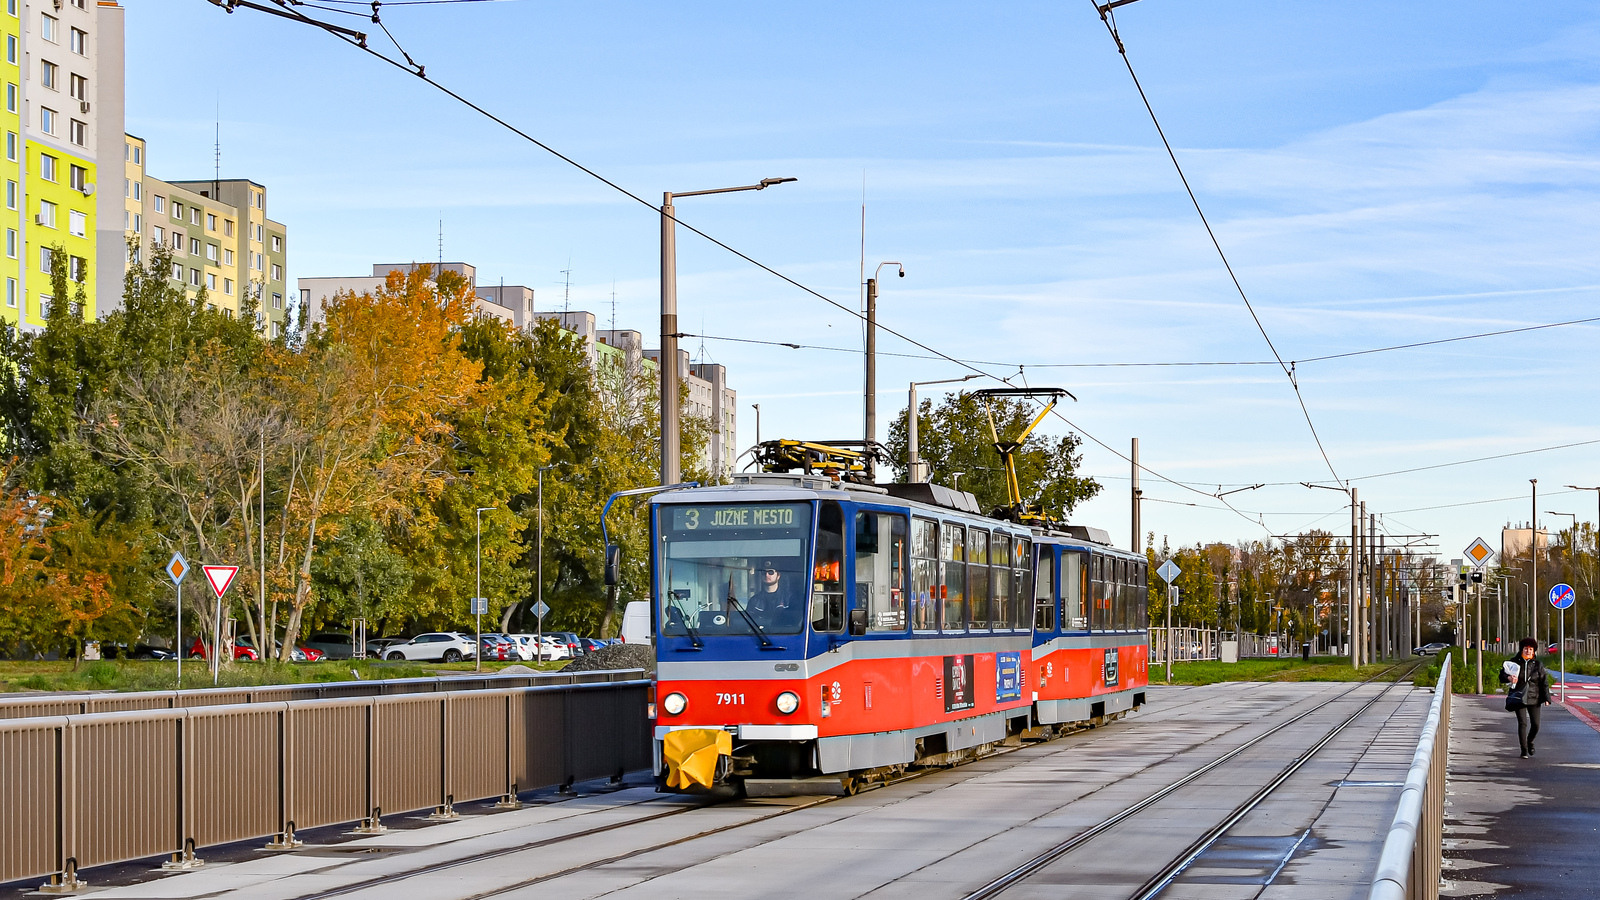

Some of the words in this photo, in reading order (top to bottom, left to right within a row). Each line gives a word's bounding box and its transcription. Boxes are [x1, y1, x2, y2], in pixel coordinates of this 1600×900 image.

[685, 509, 700, 530] 3
[753, 509, 793, 526] MESTO
[716, 693, 745, 705] 7911
